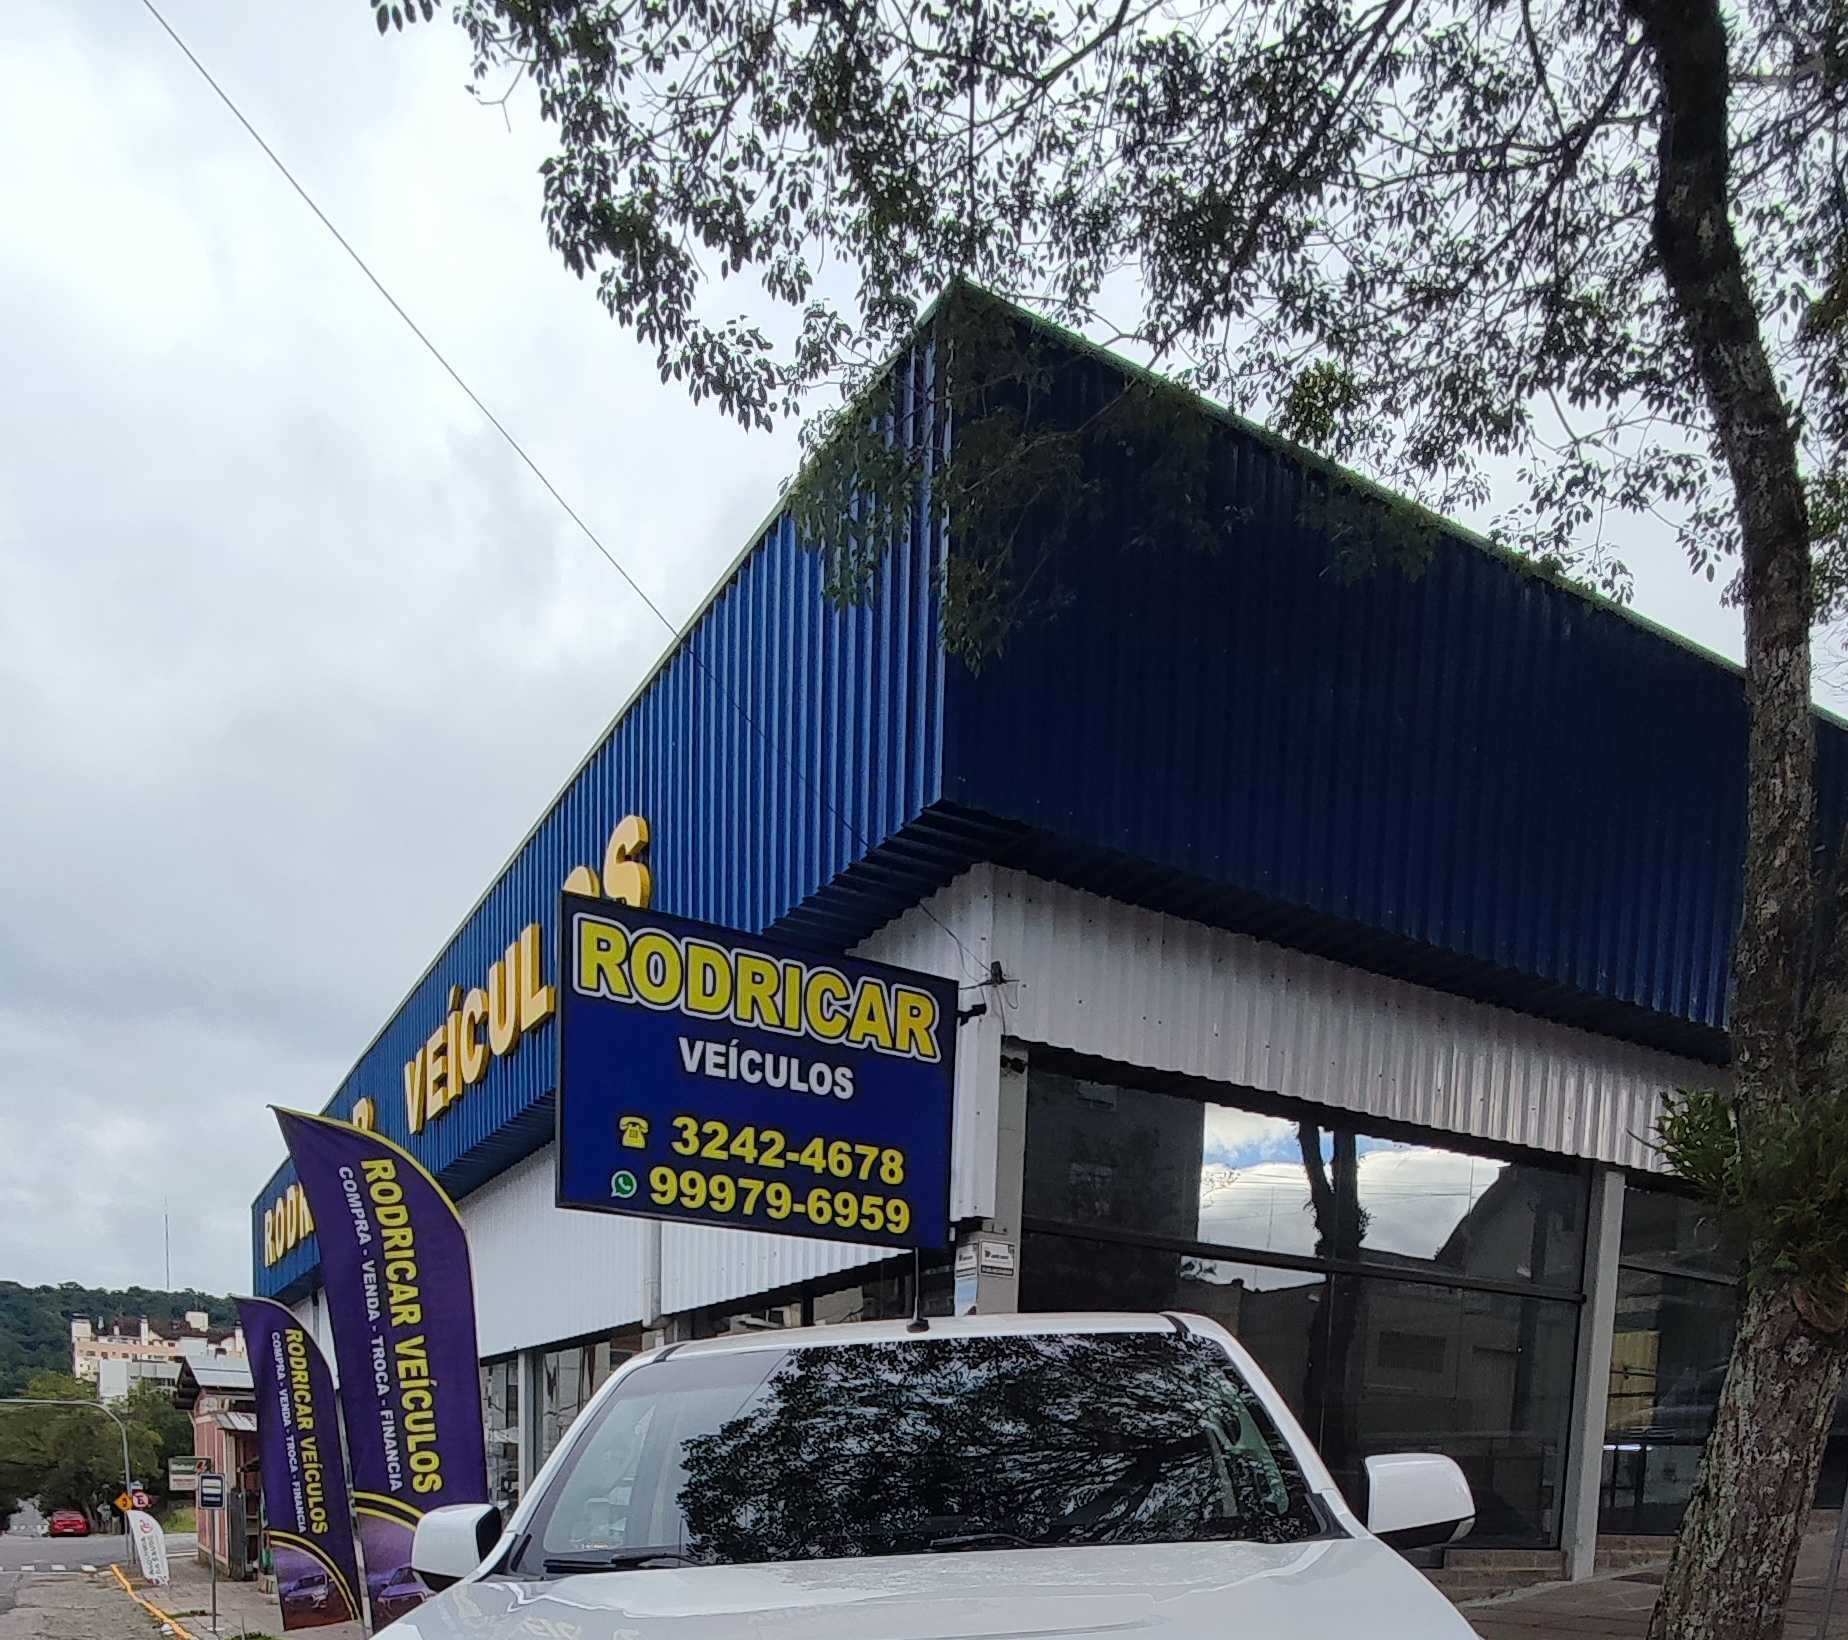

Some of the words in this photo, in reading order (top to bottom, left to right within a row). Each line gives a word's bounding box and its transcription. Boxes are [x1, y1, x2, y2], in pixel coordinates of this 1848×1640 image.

[575, 914, 941, 1061] RODRICAR
[678, 1037, 855, 1100] VEÍCULOS
[671, 1115, 905, 1186] 3242-4678
[338, 1165, 372, 1246] COMPRA
[648, 1165, 911, 1235] 99979-6959
[361, 1259, 381, 1323] VENDA
[271, 1331, 287, 1381] COMPRA
[360, 1158, 422, 1327] RODRICAR
[394, 1334, 443, 1494] VEÍCULOS
[370, 1335, 390, 1396] TROCA
[278, 1388, 292, 1427] VENDA
[284, 1327, 315, 1431] RODRICAR
[300, 1435, 329, 1536] VEÍCULOS
[285, 1434, 299, 1475] TROCA
[380, 1409, 403, 1493] FINANCIA
[291, 1481, 308, 1534] FINANCIA
